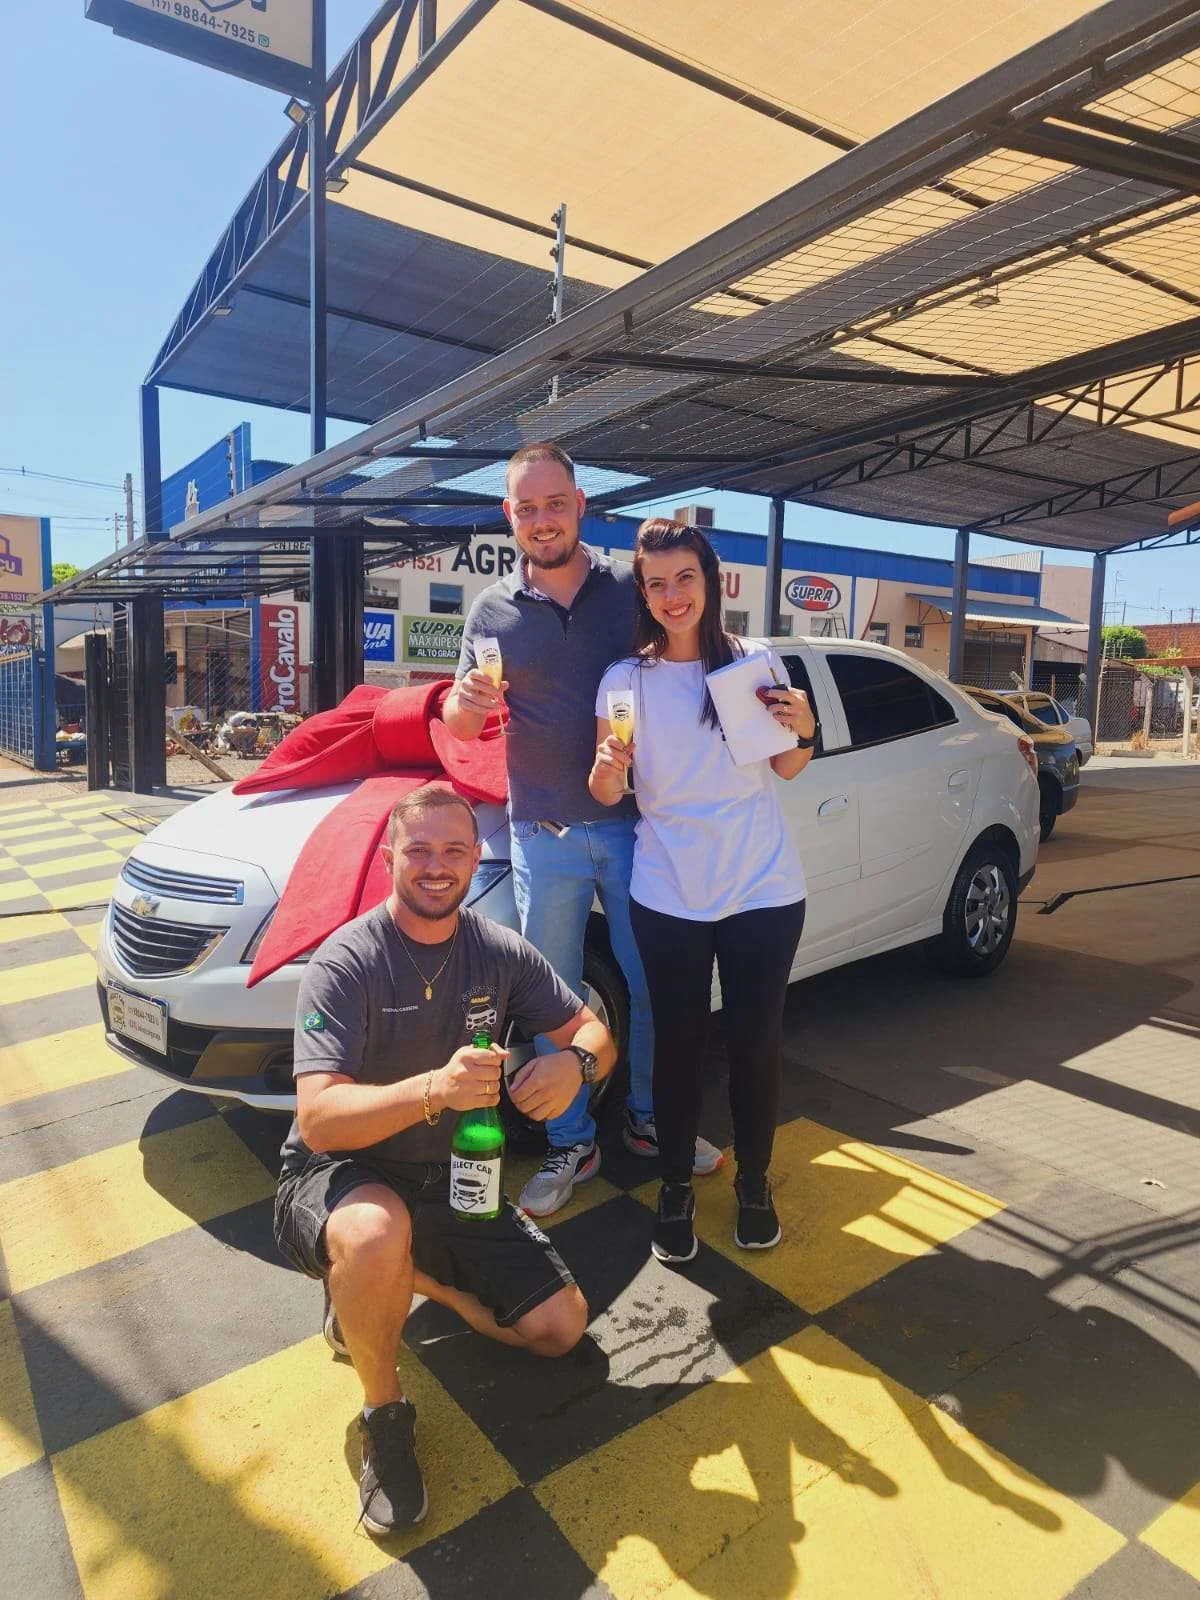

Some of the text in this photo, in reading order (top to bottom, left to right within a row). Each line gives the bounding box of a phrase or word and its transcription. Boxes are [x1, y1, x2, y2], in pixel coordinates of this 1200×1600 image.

[174, 2, 256, 43] 98844-7925
[791, 584, 834, 602] SUPRA
[364, 622, 392, 640] UA
[409, 621, 465, 637] SUPRA
